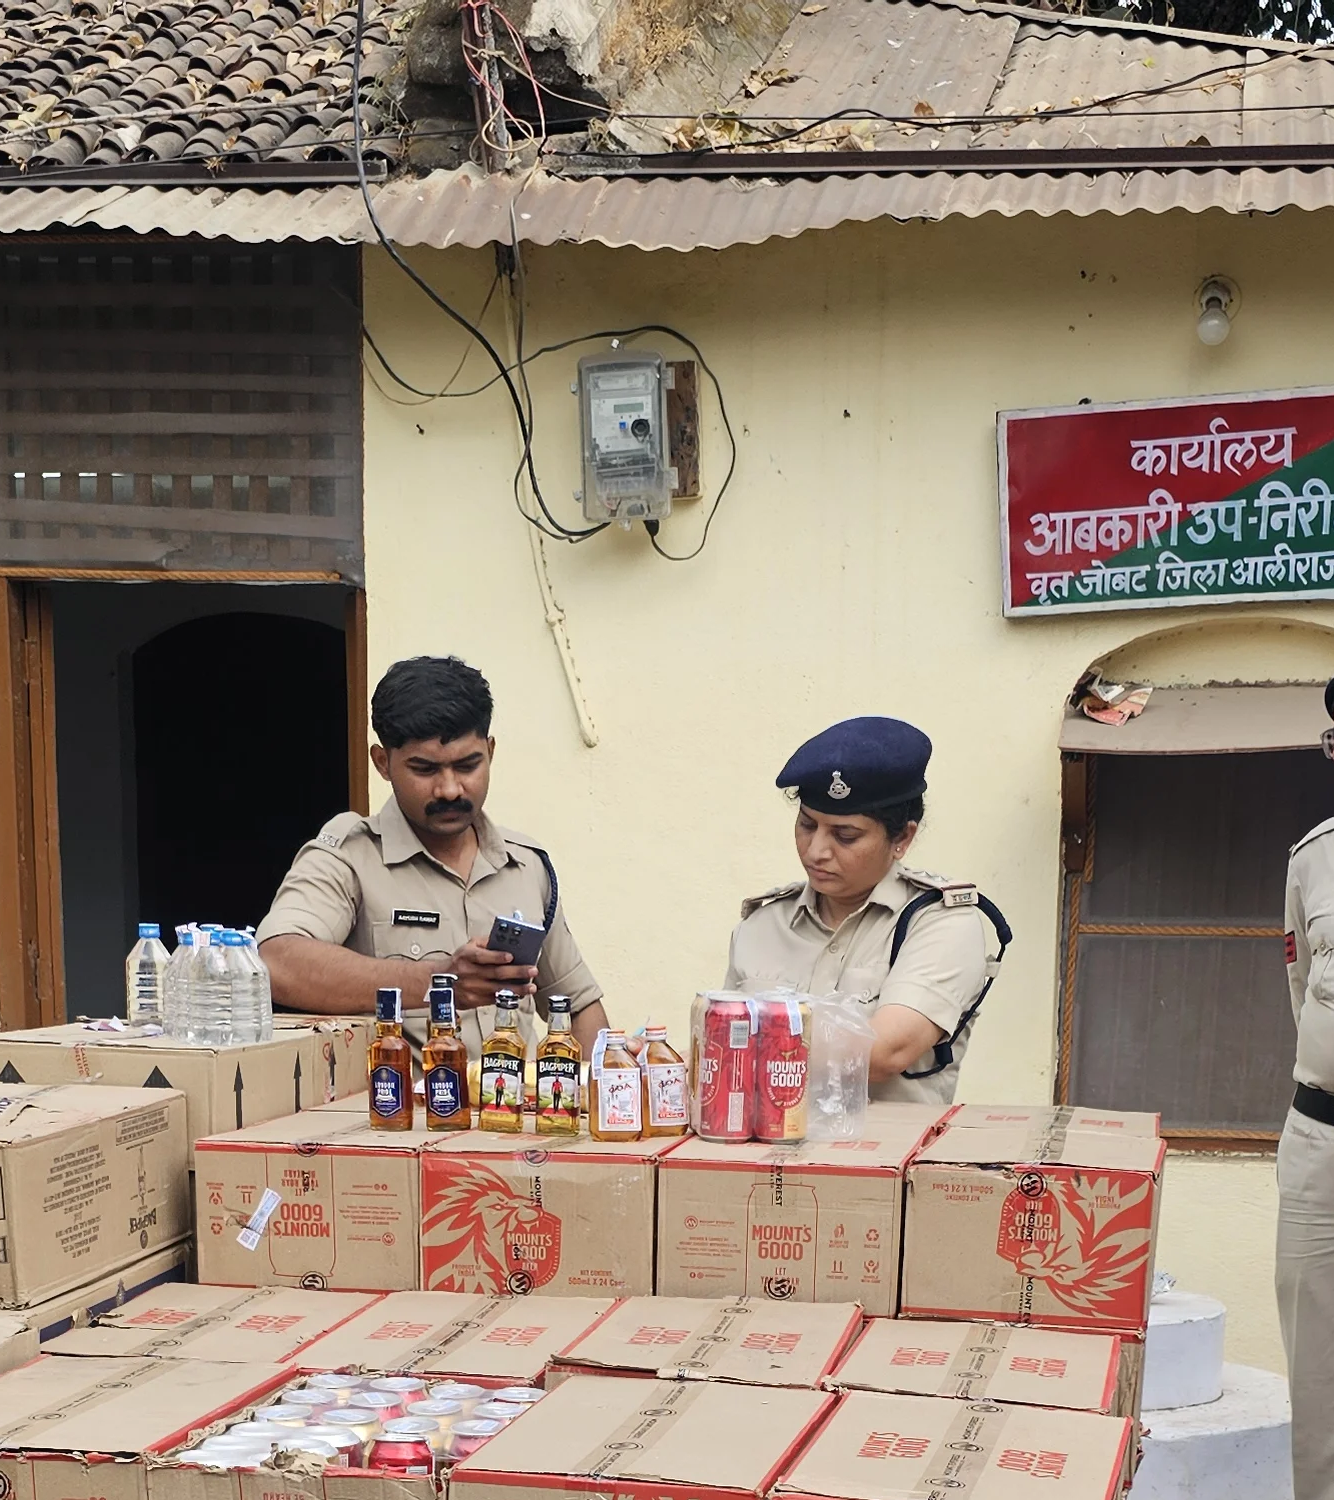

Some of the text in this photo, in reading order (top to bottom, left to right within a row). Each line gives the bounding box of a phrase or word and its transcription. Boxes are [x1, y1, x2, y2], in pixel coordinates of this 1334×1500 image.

[1130, 416, 1297, 477] कार्यालय
[1024, 488, 1182, 555] आबकारी
[1075, 560, 1150, 597] जोबट
[1155, 551, 1229, 592] जिला
[483, 1057, 519, 1071] BAGPIPER
[539, 1060, 575, 1074] BAGPIPER
[766, 1058, 807, 1074] MOUNT'S
[770, 1073, 802, 1088] 6000
[775, 1165, 783, 1207] EVEREST
[280, 1203, 323, 1221] 6000
[273, 1221, 330, 1238] MOUNT'S
[751, 1224, 812, 1243] MOUNT'S
[506, 1232, 553, 1246] MOUNT'S
[758, 1242, 803, 1261] 6000
[774, 1267, 786, 1276] LET
